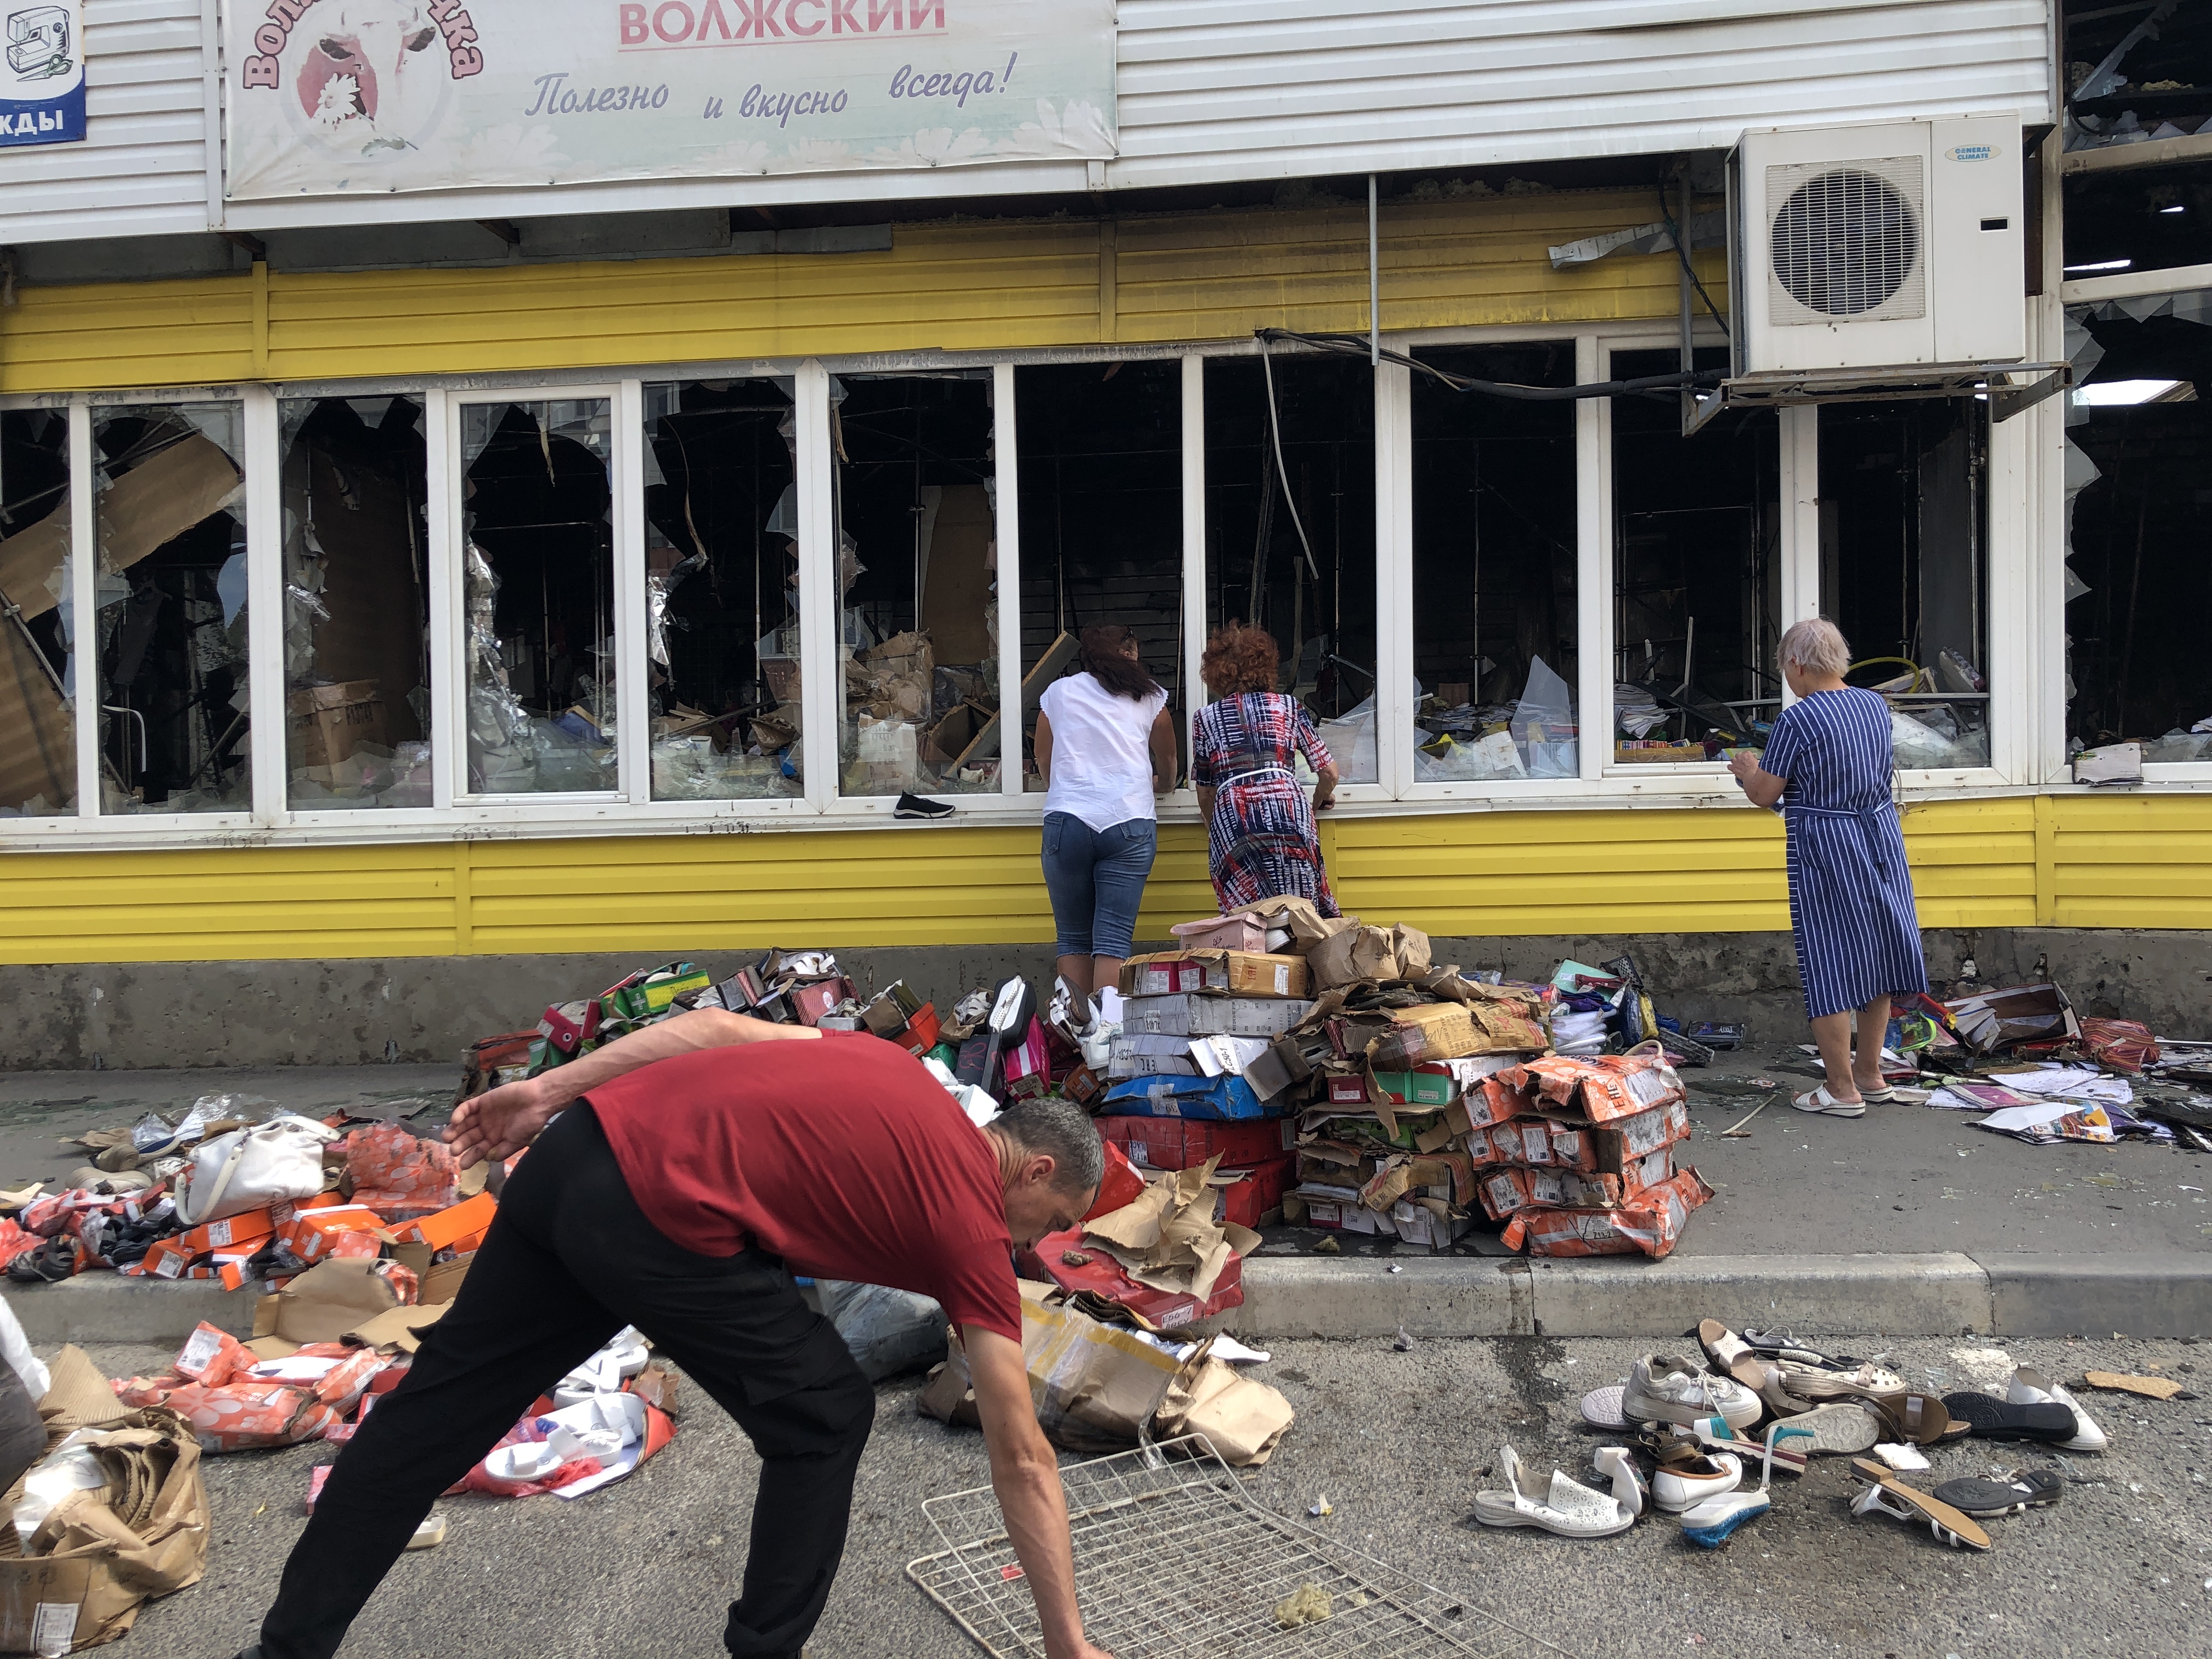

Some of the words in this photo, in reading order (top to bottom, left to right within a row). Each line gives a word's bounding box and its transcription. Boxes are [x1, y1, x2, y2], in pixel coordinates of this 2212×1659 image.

[524, 72, 669, 116] Полезно
[703, 96, 723, 119] и
[738, 84, 848, 128] вкусно
[888, 51, 1018, 108] всегда!
